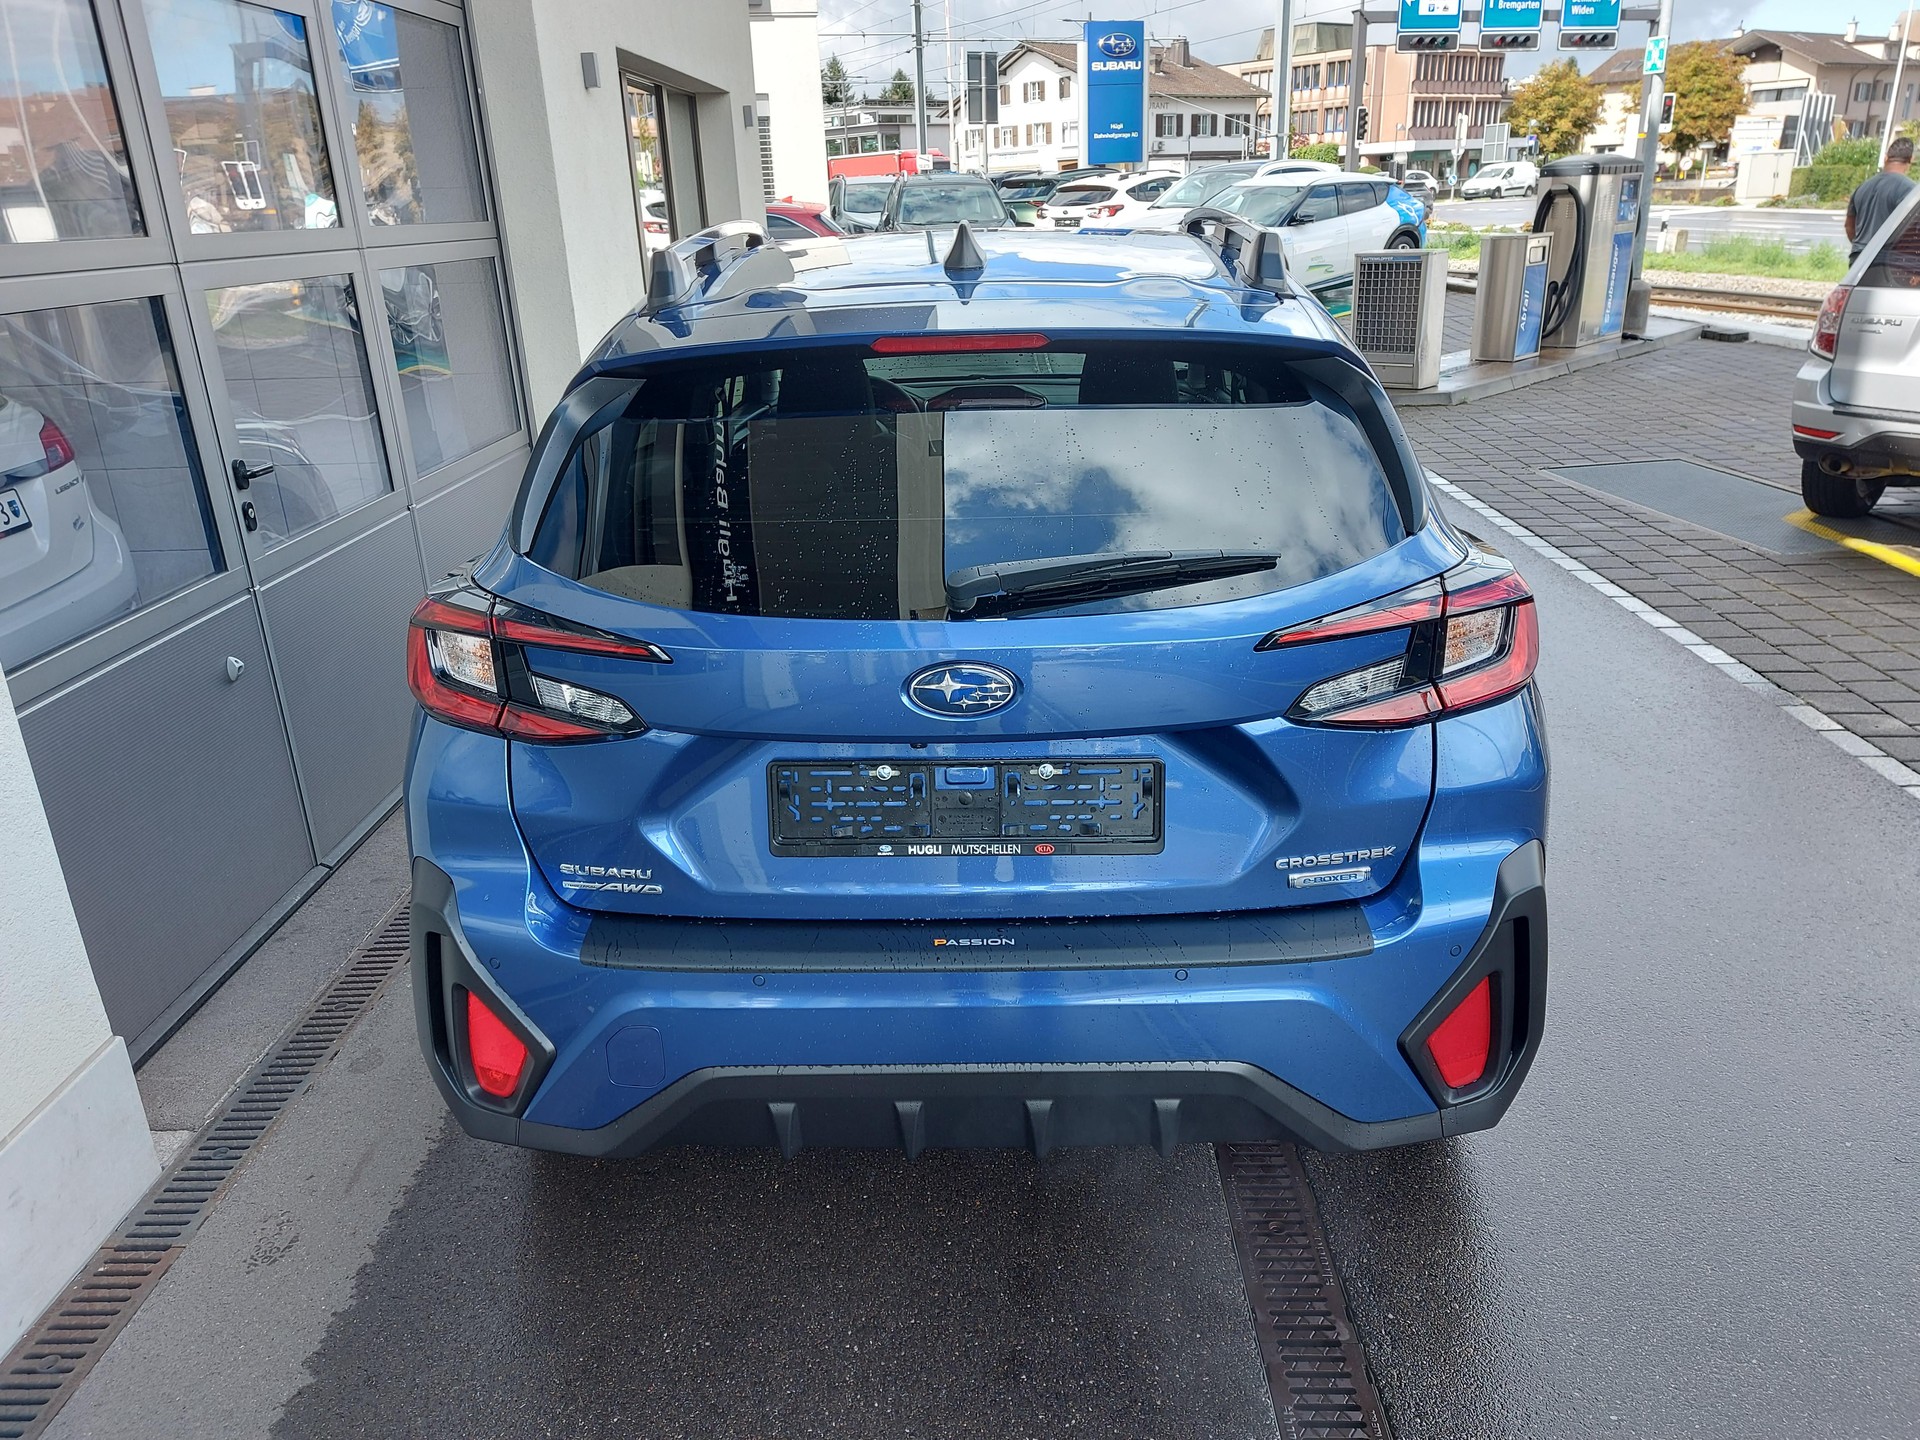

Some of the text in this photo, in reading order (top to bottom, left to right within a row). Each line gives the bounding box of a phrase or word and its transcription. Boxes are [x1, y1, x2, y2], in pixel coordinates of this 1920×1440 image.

[1498, 0, 1540, 11] Bremgarten
[1571, 4, 1595, 15] Widen
[1091, 61, 1141, 71] SUBARU
[1604, 243, 1619, 324] Staubsauger
[1520, 289, 1530, 331] Abfall
[1850, 317, 1903, 327] SUBARU
[54, 477, 80, 495] LEGACY
[907, 844, 1021, 855] HUGLI MUTSCHELLEN
[1275, 845, 1397, 870] CROSSTREK
[560, 863, 652, 879] SUBARU
[600, 883, 662, 894] AWD
[934, 938, 1015, 946] PASSION
